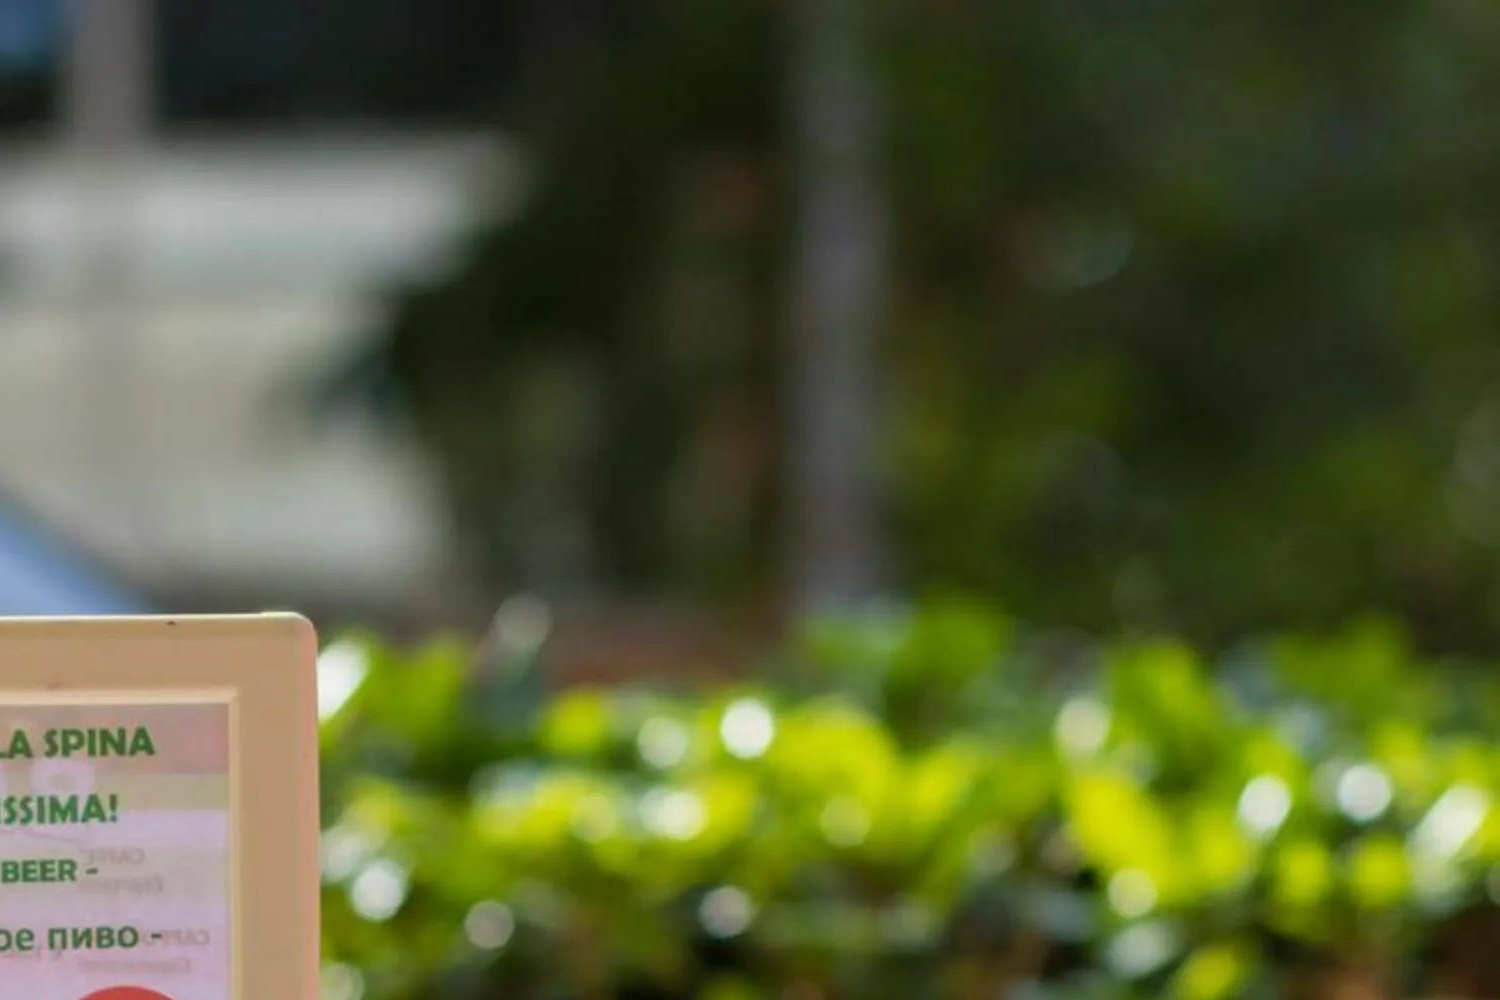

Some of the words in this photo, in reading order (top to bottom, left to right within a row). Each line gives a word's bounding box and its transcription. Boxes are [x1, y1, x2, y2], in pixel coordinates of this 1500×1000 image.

[41, 724, 156, 759] SPINA
[0, 857, 78, 885] BEER
[47, 926, 140, 952] пиво
